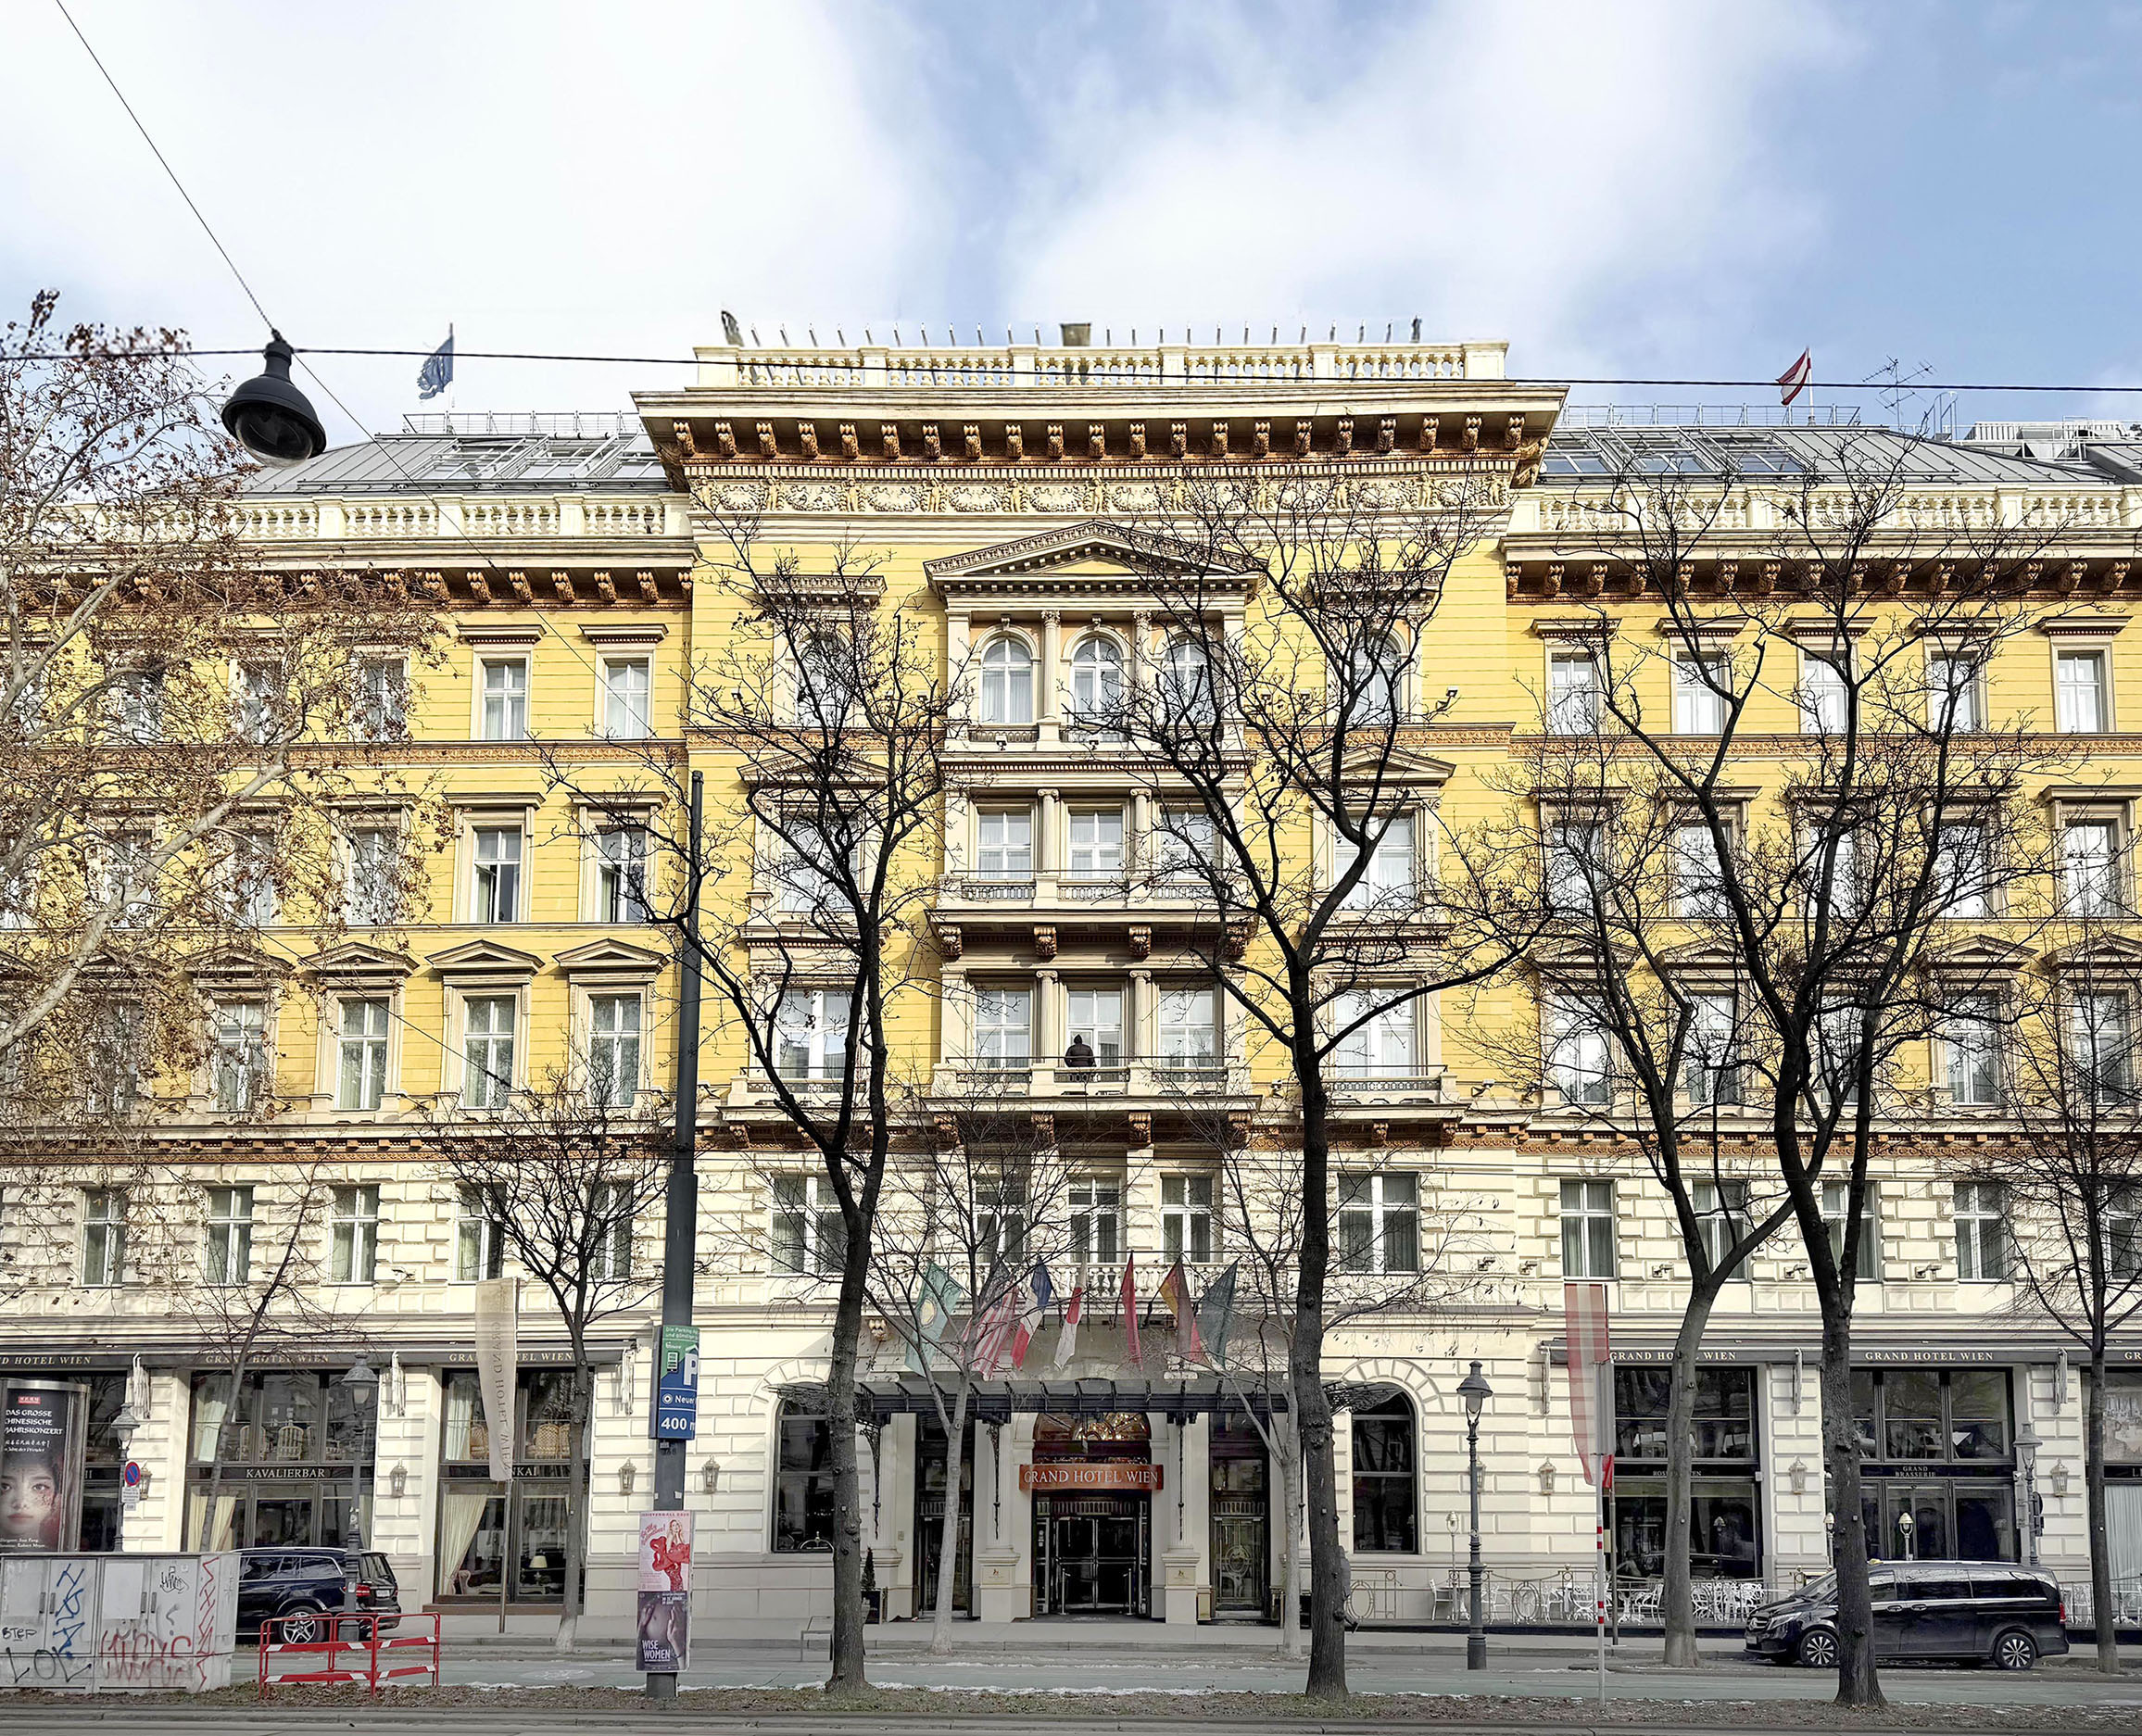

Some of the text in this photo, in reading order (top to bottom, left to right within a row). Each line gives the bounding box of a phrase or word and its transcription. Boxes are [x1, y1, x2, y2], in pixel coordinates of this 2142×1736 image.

[15, 1356, 56, 1365] HOTEL
[59, 1356, 92, 1365] WIEN
[252, 1355, 292, 1364] HOTEL
[297, 1354, 330, 1364] WIEN
[449, 1353, 476, 1362] GRA
[541, 1352, 573, 1361] WIEN
[1609, 1352, 1652, 1360] GRAND
[1703, 1352, 1736, 1360] WIEN
[1865, 1352, 1993, 1361] GRAND HOTEL WIEN
[21, 1409, 53, 1417] GROSSE
[661, 1416, 687, 1430] 400
[246, 1468, 325, 1478] KAVALIERBAR
[511, 1466, 536, 1477] NKAI
[1024, 1471, 1159, 1483] GRAND HOTEL WIEN
[642, 1640, 659, 1650] WISE
[643, 1649, 671, 1659] WOMEN
[5, 1646, 92, 1683] LOL
